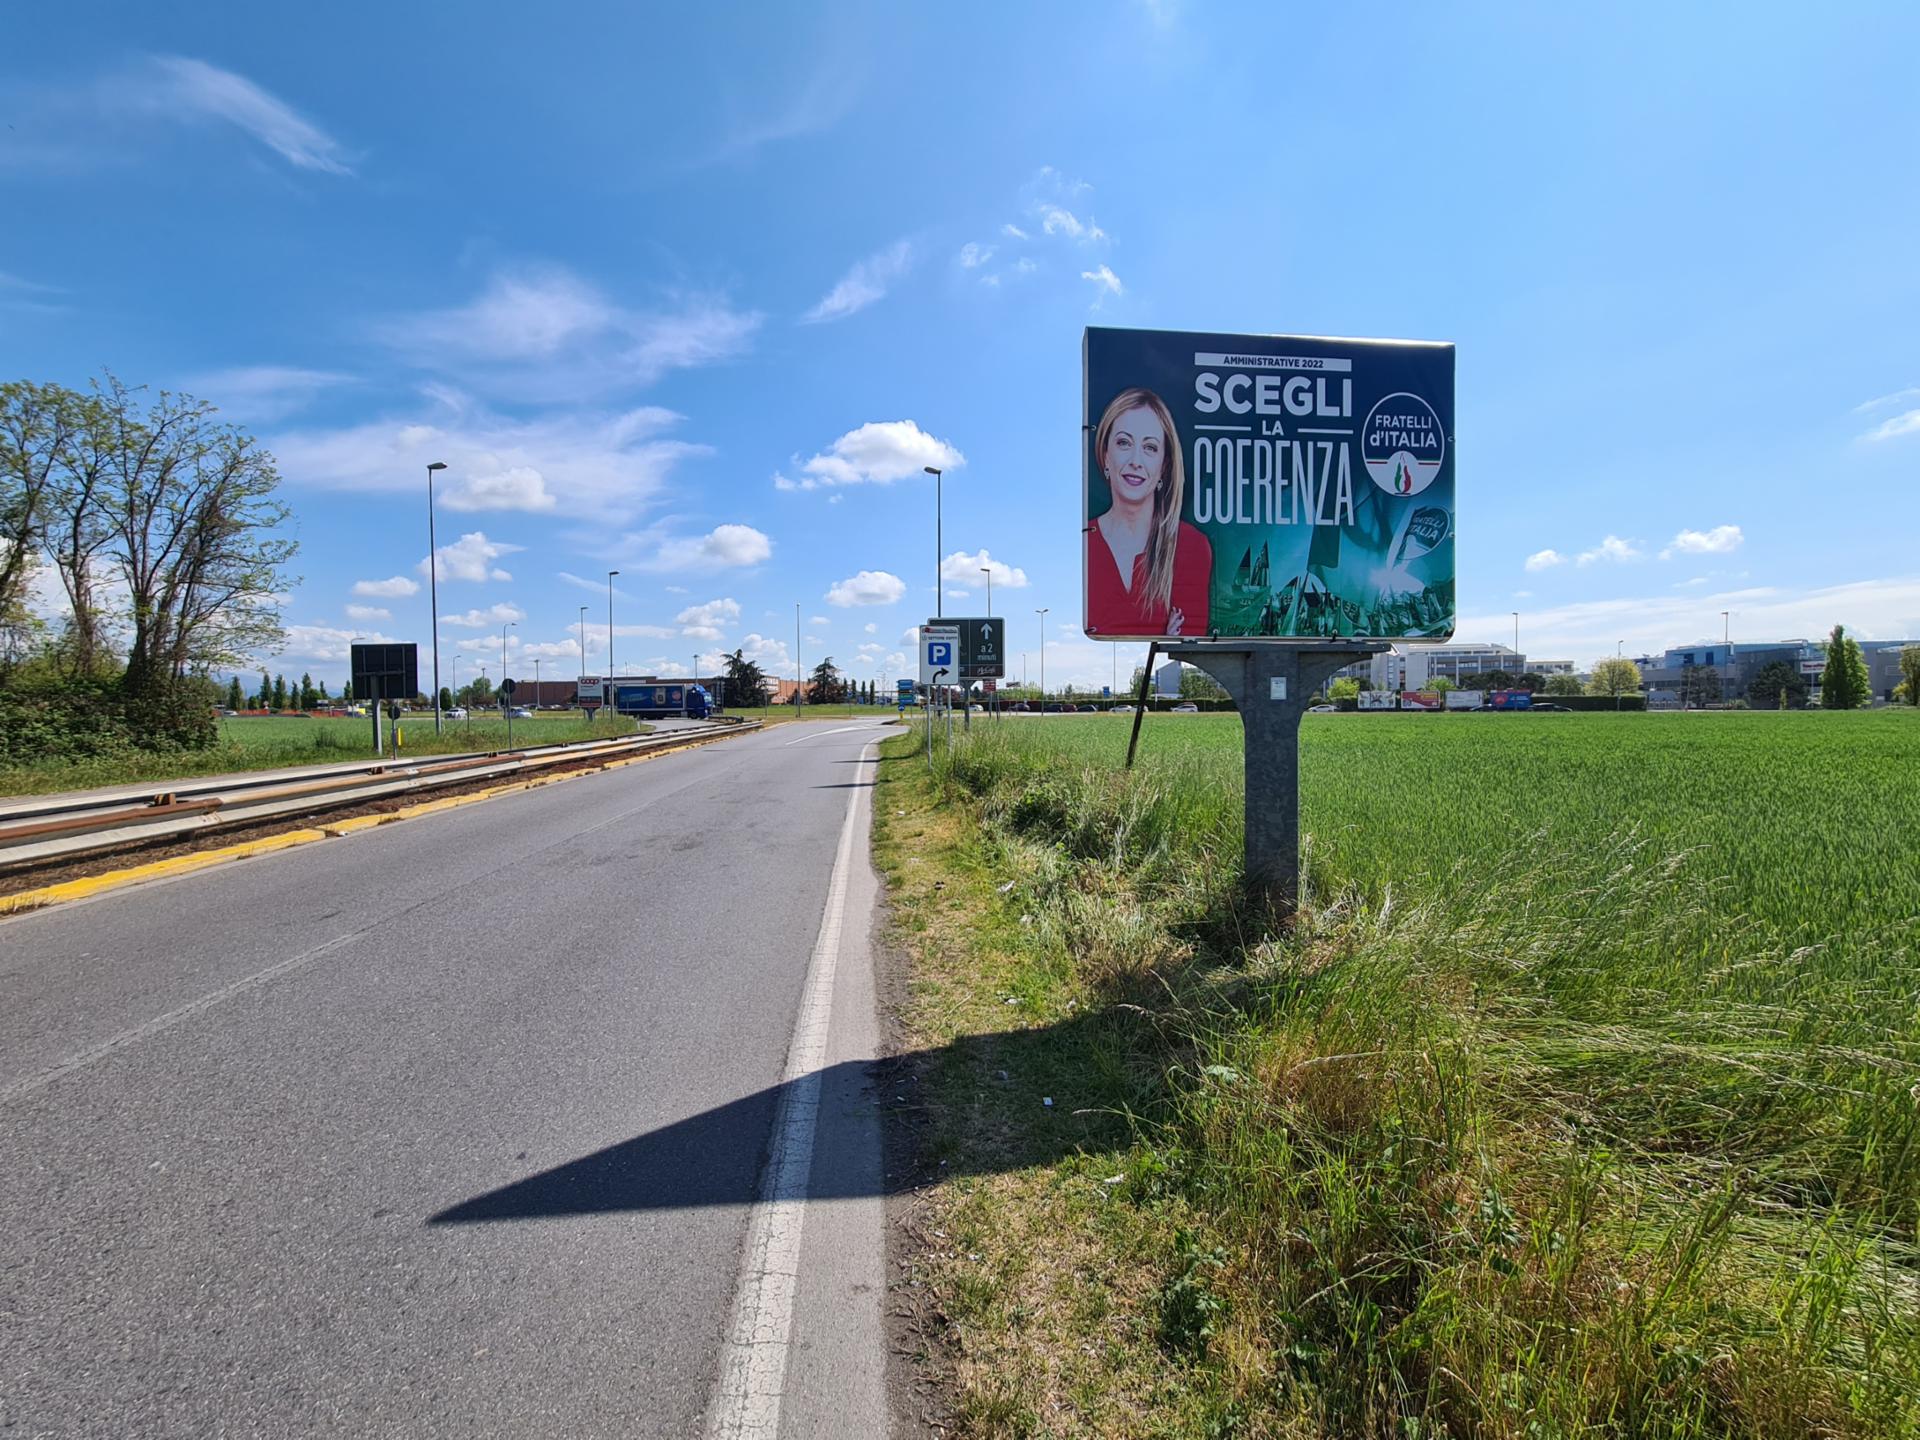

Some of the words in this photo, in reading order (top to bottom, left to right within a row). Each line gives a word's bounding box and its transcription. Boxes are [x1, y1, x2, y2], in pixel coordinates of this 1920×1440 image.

[1223, 356, 1300, 368] AMMINISTRATIVE
[1302, 359, 1324, 368] 2022
[1194, 372, 1352, 417] SCEGLI
[1262, 420, 1284, 436] LA
[1375, 414, 1432, 429] FRATELLI
[1369, 430, 1438, 448] d'ITALIA
[1193, 437, 1354, 526] COERENZA
[932, 645, 946, 663] P
[980, 645, 986, 653] a
[987, 643, 993, 653] 2
